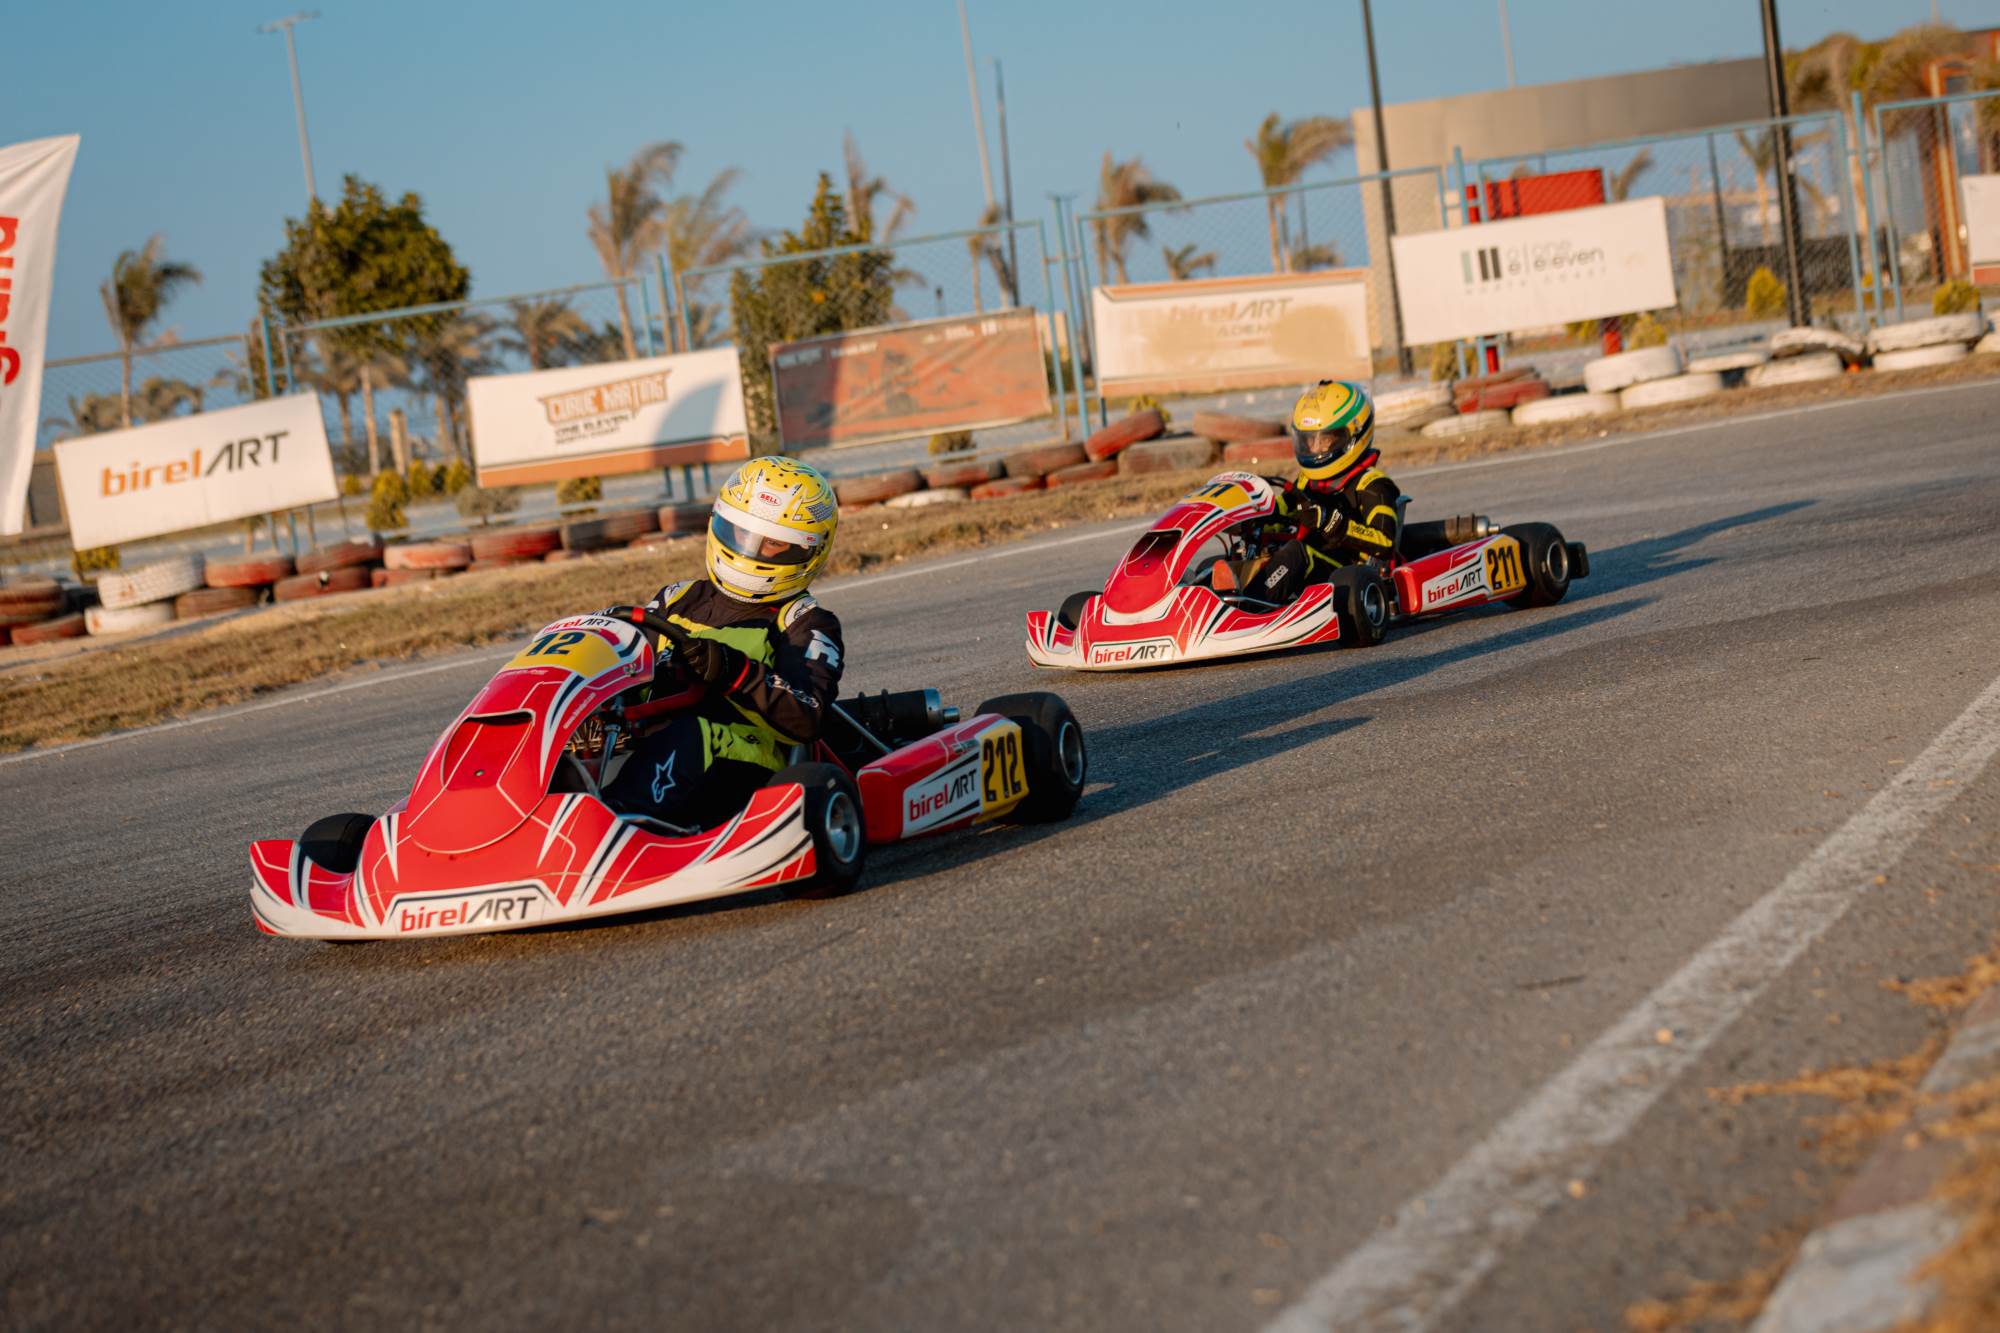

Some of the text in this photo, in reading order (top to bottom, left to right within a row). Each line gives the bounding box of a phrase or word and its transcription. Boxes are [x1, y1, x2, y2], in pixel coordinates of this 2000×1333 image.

[1533, 248, 1605, 273] eleven
[101, 428, 290, 498] birelART
[760, 493, 778, 505] BELL
[1428, 567, 1483, 604] birelART
[1487, 545, 1520, 592] 211
[1094, 644, 1171, 665] birelART
[983, 731, 1022, 803] 212
[909, 768, 977, 822] birelART
[400, 896, 538, 933] birelART
